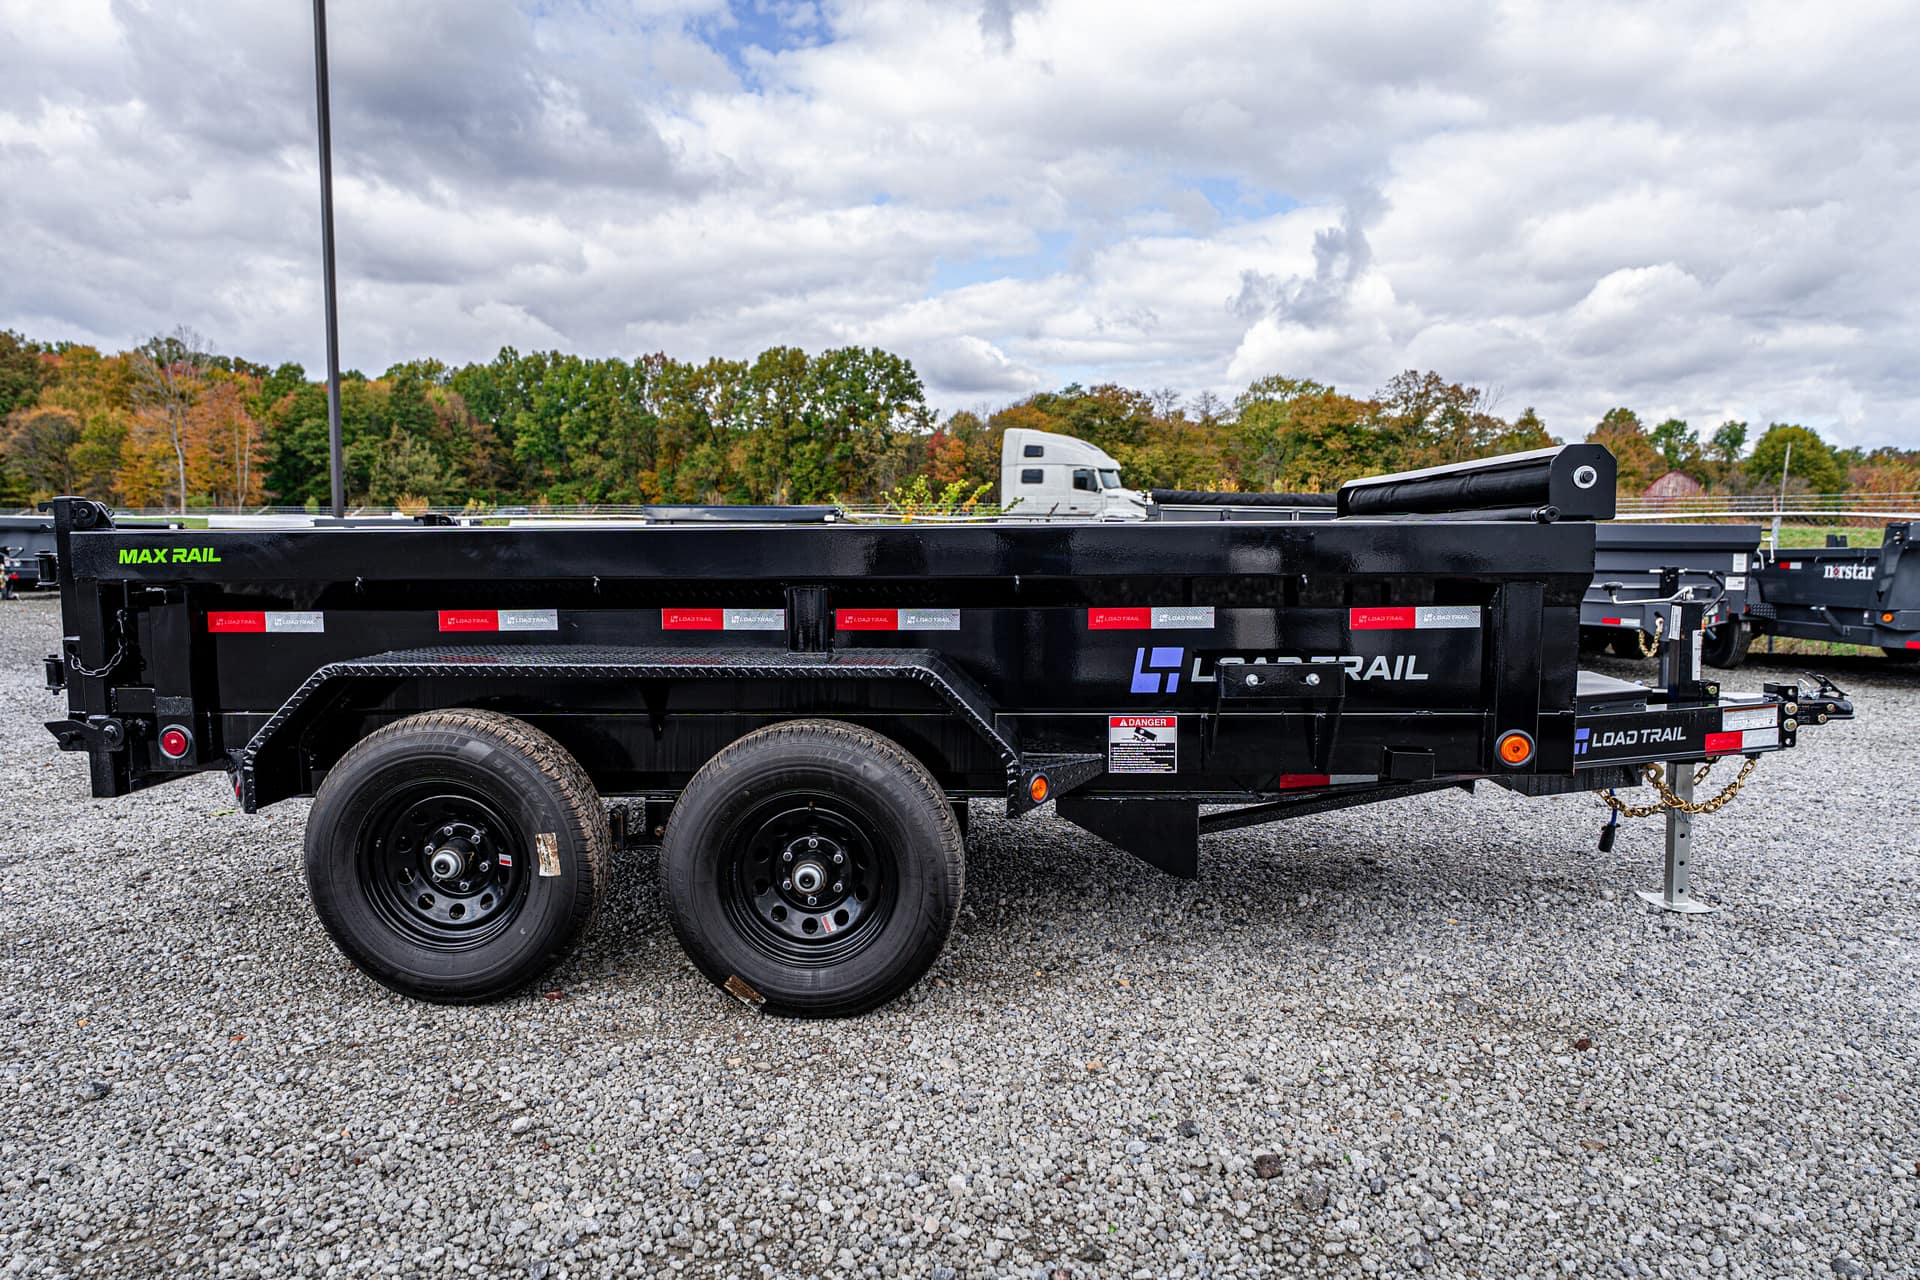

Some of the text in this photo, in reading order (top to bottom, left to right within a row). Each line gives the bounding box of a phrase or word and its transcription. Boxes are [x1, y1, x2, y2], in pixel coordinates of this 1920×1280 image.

[119, 547, 221, 564] MAX RAIL
[1310, 655, 1429, 681] RAIL
[1128, 718, 1167, 727] DANGER
[1592, 726, 1687, 747] LOAD TRAIL
